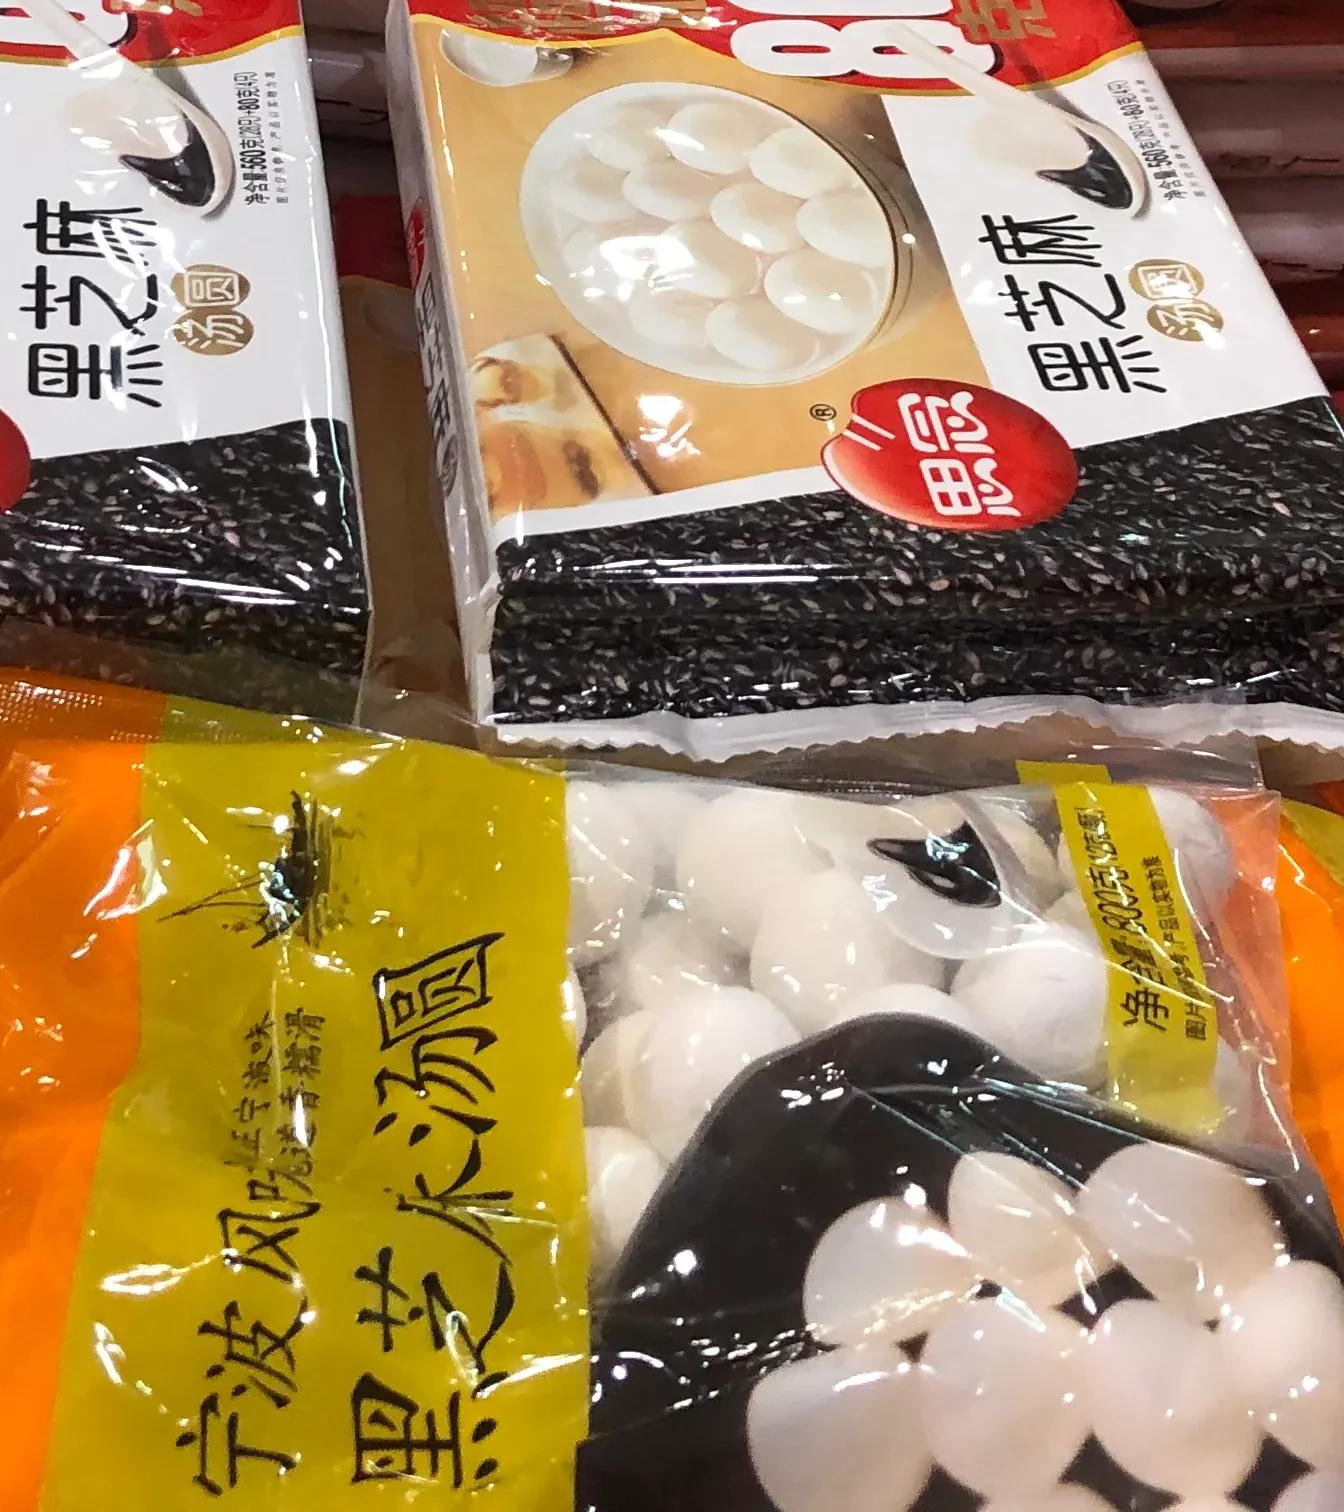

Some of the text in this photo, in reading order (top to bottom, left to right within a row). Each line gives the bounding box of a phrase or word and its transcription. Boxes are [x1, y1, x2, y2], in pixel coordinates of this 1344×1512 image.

[18, 197, 165, 409] 黑芝麻
[175, 266, 254, 355] 汤圆
[977, 213, 1168, 395] 黑芝麻
[1131, 261, 1222, 342] 汤圆
[897, 391, 1022, 518] 思念
